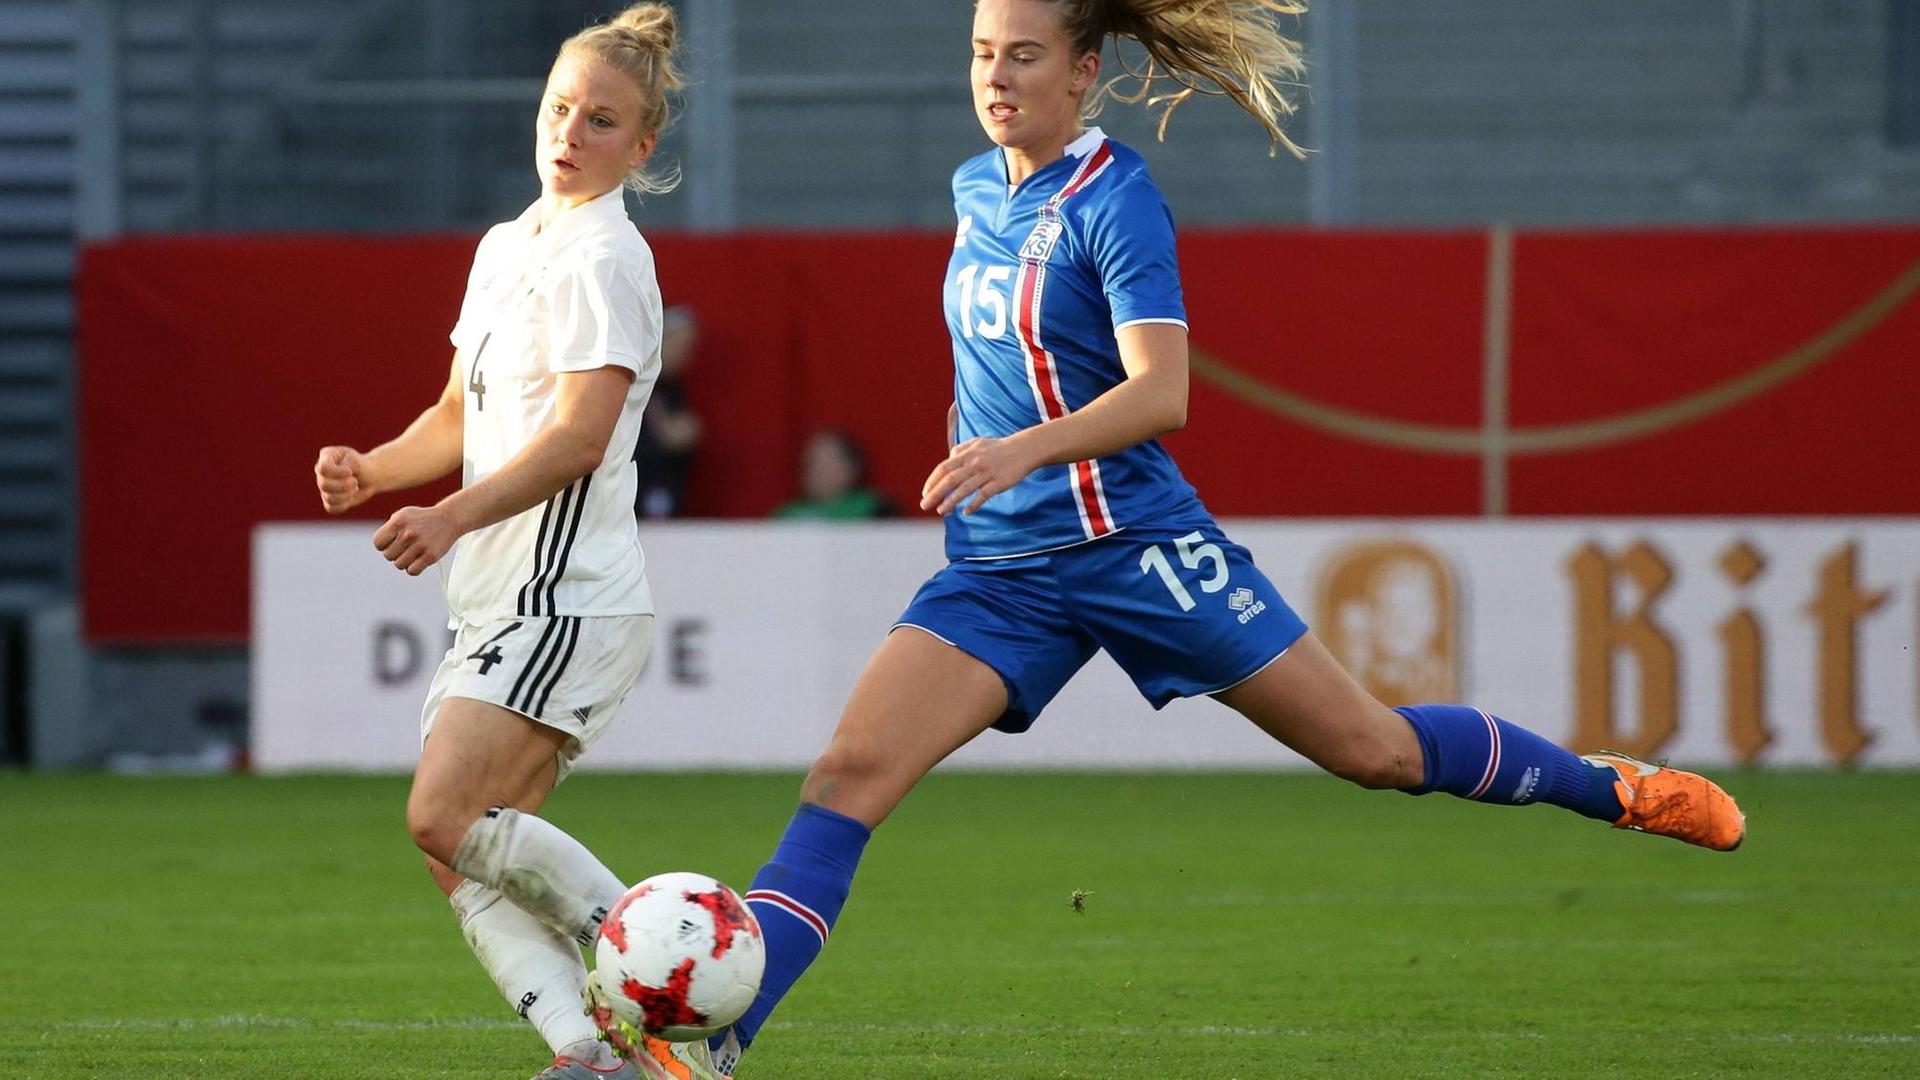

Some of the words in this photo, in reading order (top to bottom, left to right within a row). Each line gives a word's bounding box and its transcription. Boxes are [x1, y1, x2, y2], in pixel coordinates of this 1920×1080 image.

[955, 263, 1010, 340] 15
[469, 331, 492, 412] 4
[1139, 530, 1230, 613] 15
[466, 620, 524, 676] 4
[1236, 599, 1267, 625] errea
[1560, 536, 1920, 768] Bit
